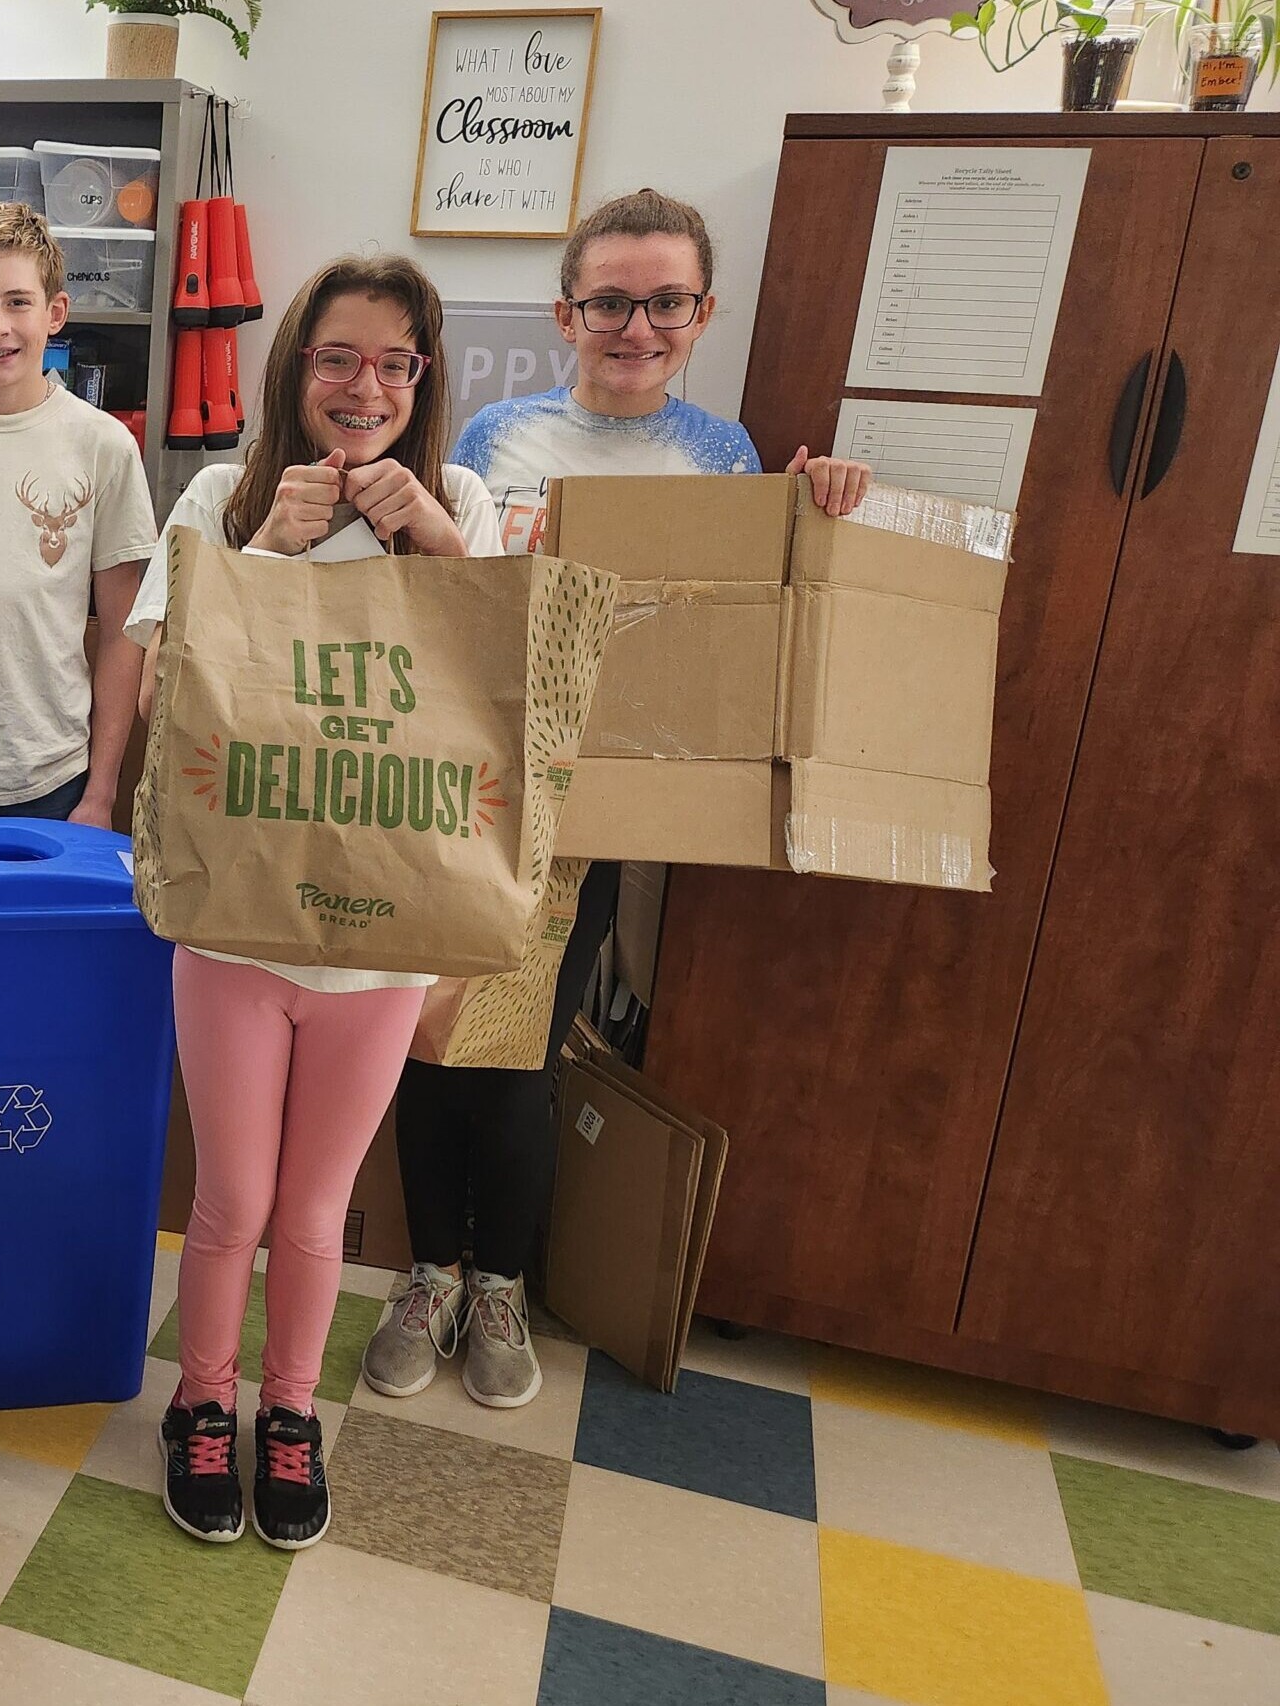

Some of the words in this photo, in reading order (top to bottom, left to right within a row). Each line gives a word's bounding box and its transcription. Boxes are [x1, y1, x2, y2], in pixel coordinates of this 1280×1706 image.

[456, 48, 500, 73] WHAT
[508, 49, 514, 73] I
[524, 30, 572, 75] love
[486, 86, 517, 103] MOST
[518, 86, 557, 103] ABOUT
[558, 86, 576, 103] MY
[436, 96, 574, 145] Classroom
[479, 159, 492, 176] IS
[498, 159, 521, 176] WHO
[526, 159, 532, 176] I
[435, 171, 499, 211] share
[500, 189, 516, 210] IT
[521, 189, 556, 210] WITH
[190, 221, 199, 259] RAYOVAC
[292, 639, 417, 714] LET'S
[320, 716, 394, 744] GET
[225, 741, 473, 839] DELICIOUS!
[295, 882, 397, 919] Panera
[319, 912, 369, 930] BREAD
